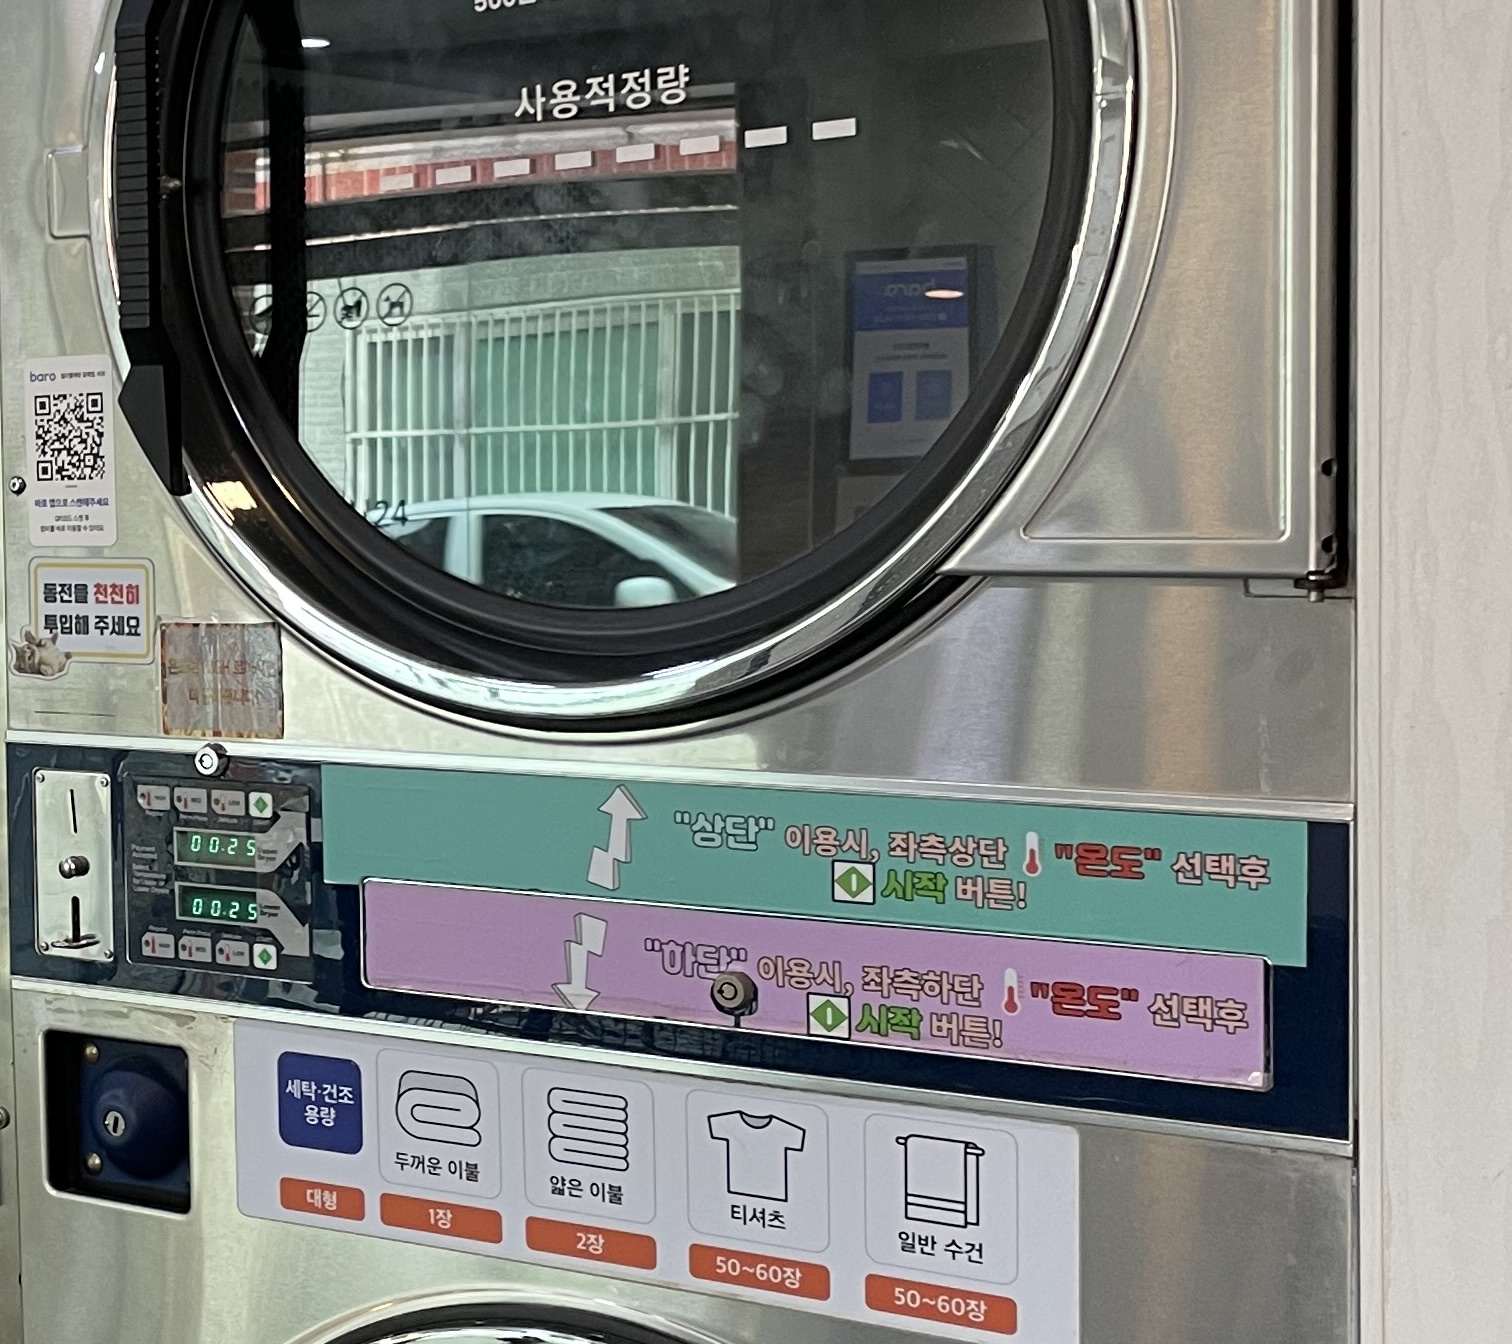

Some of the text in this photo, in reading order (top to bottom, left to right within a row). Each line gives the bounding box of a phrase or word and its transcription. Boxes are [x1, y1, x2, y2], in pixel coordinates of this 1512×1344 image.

[512, 64, 692, 128] 사용적정량
[30, 371, 56, 382] baro
[43, 583, 139, 604] 동전을 천천히
[44, 614, 141, 636] 투입해 주세요
[674, 810, 1271, 891] "상단" 이용시, 좌측상단 "온도" 선택후
[880, 869, 1027, 911] 시작 버튼!
[756, 956, 854, 999] 이용시,
[862, 965, 984, 1008] 좌측하단
[1030, 982, 1139, 1021] "온도"
[1147, 993, 1249, 1035] 선택후
[855, 1003, 1003, 1049] 시작 버튼!
[304, 1105, 335, 1126] 용량
[394, 1152, 480, 1182] 두꺼운 이불
[307, 1189, 336, 1210] 대형
[550, 1176, 623, 1205] 얇은 이불
[429, 1209, 452, 1228] 1장
[731, 1205, 786, 1229] 티셔츠
[577, 1233, 604, 1254] 2장
[899, 1231, 983, 1264] 일반 수건
[716, 1256, 802, 1288] 50~60장
[895, 1288, 987, 1321] 50~60장
